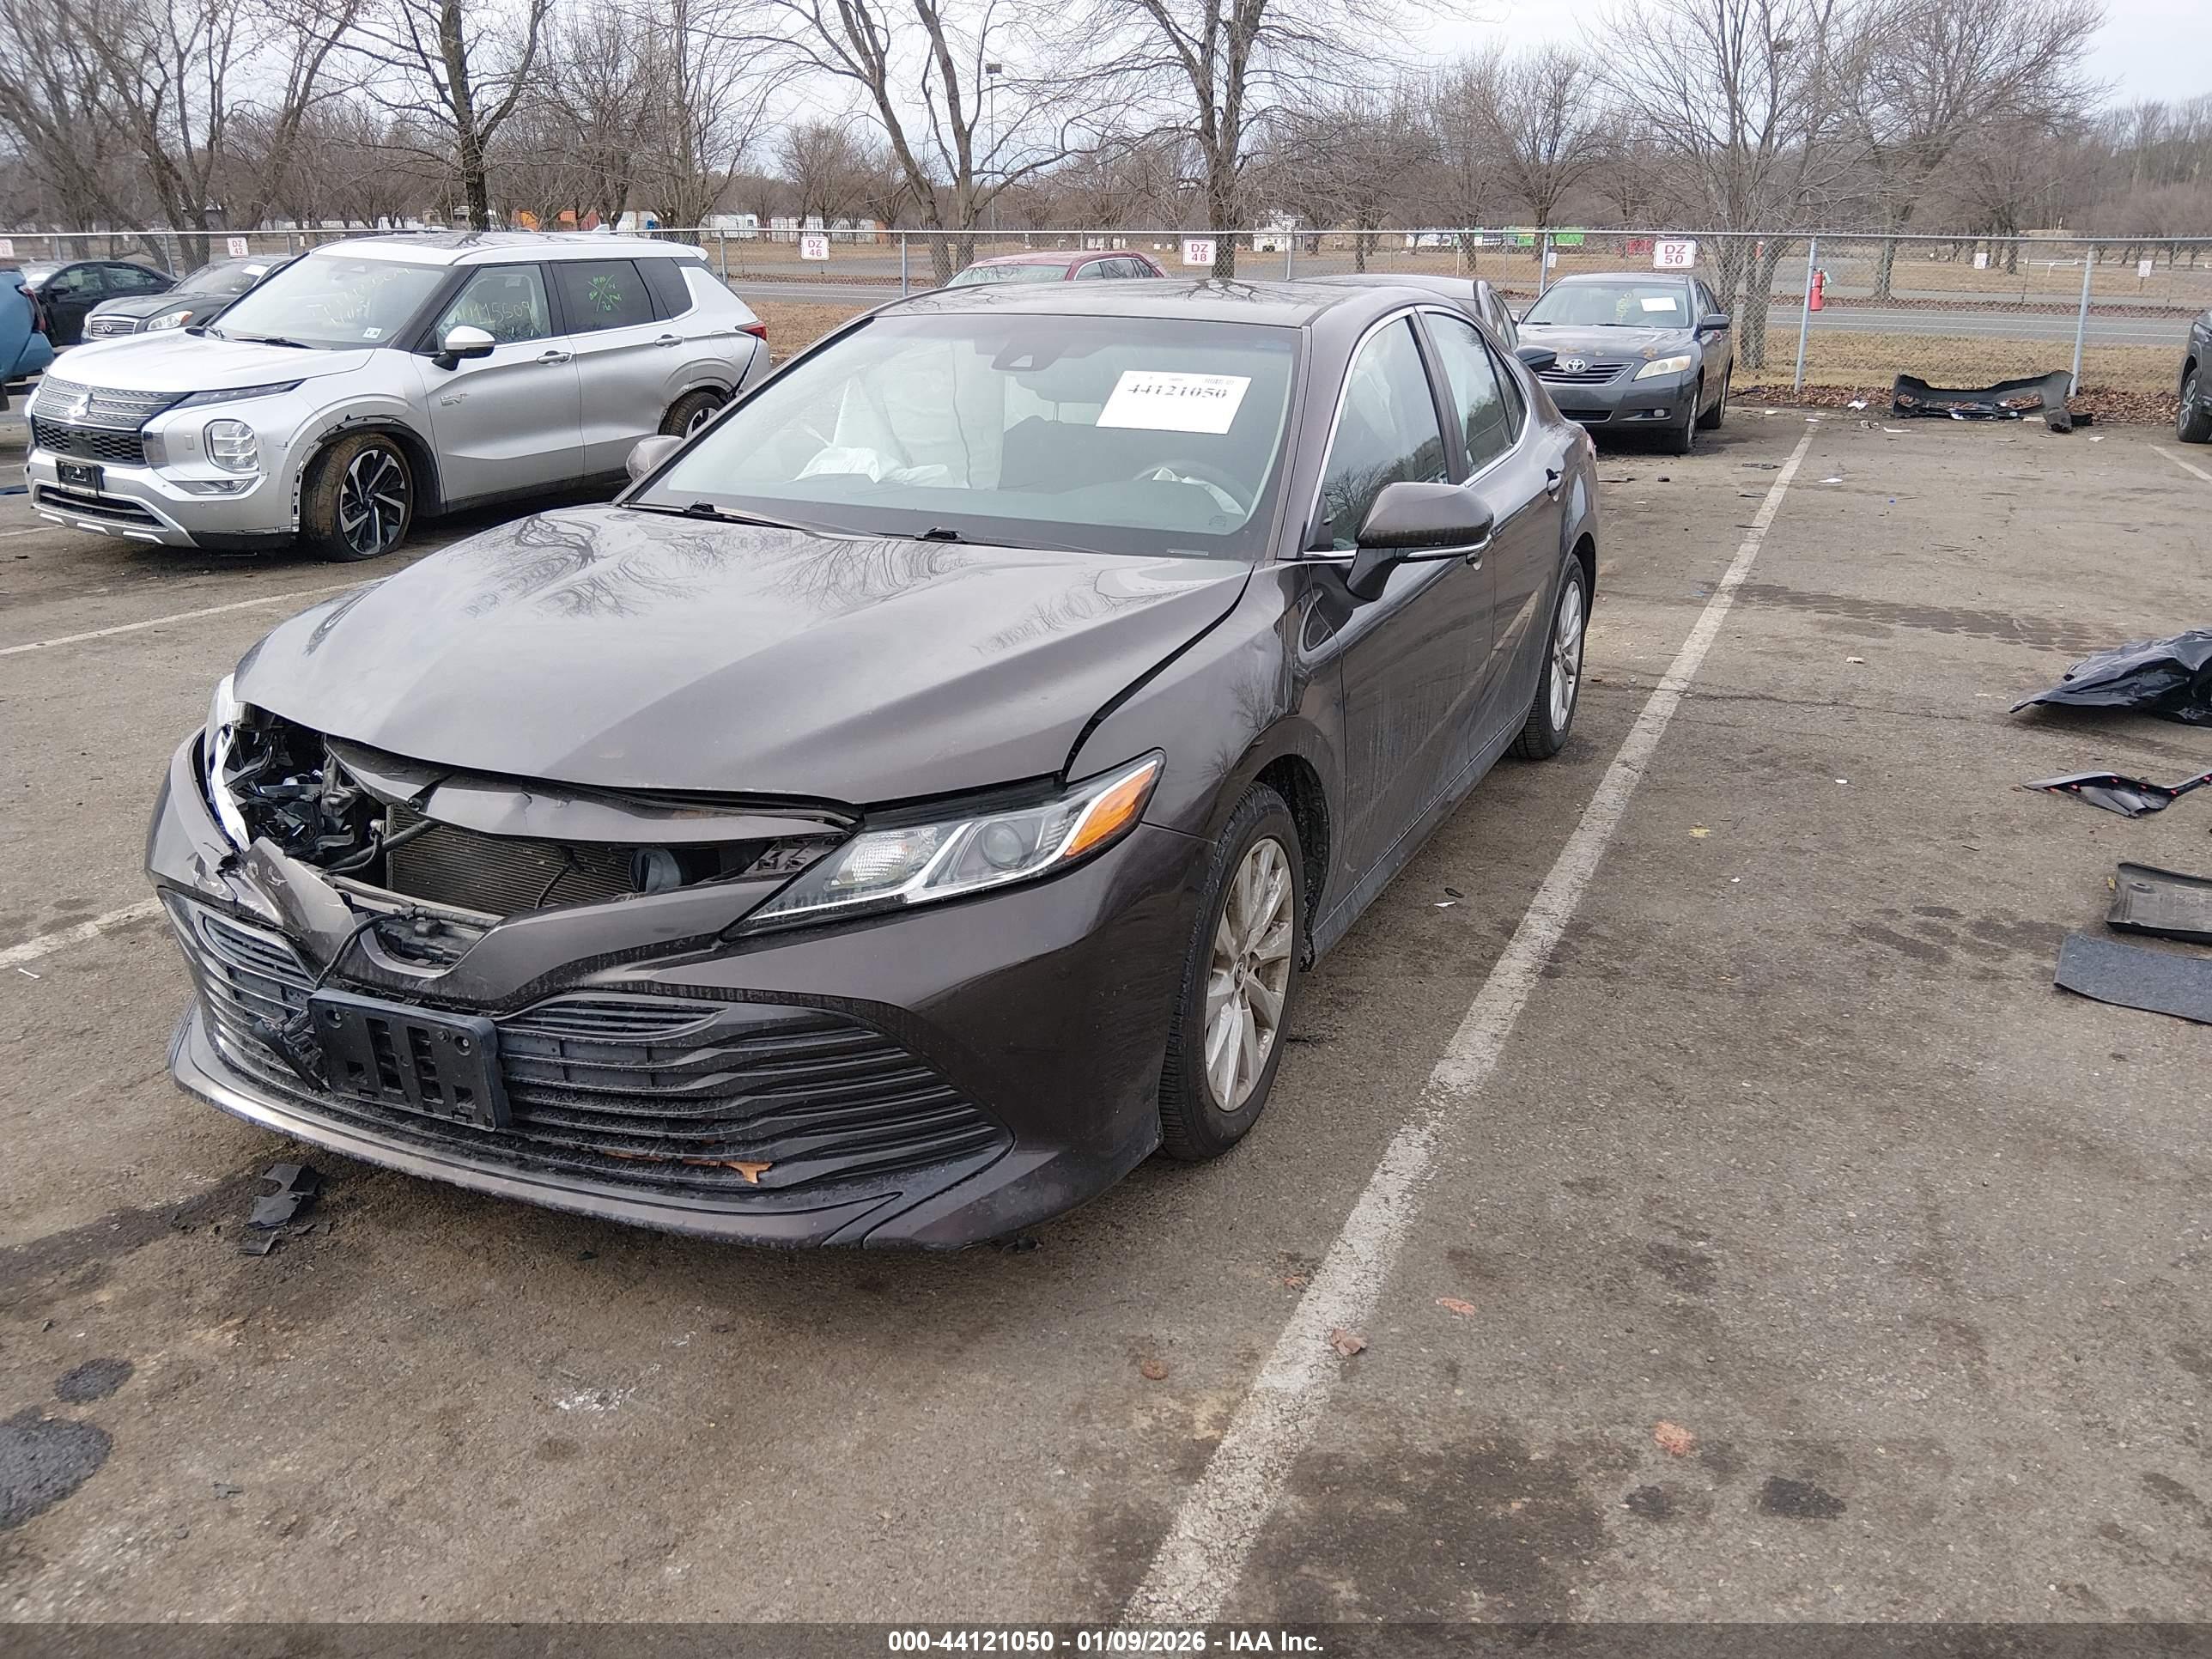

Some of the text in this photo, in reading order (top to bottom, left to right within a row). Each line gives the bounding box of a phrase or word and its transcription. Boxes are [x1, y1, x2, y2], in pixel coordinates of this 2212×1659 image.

[807, 240, 823, 248] DZ
[1191, 243, 1208, 253] DZ
[1664, 245, 1686, 254] DZ
[1191, 253, 1206, 262] 48
[1664, 255, 1684, 264] 50
[1127, 384, 1227, 398] 44121050
